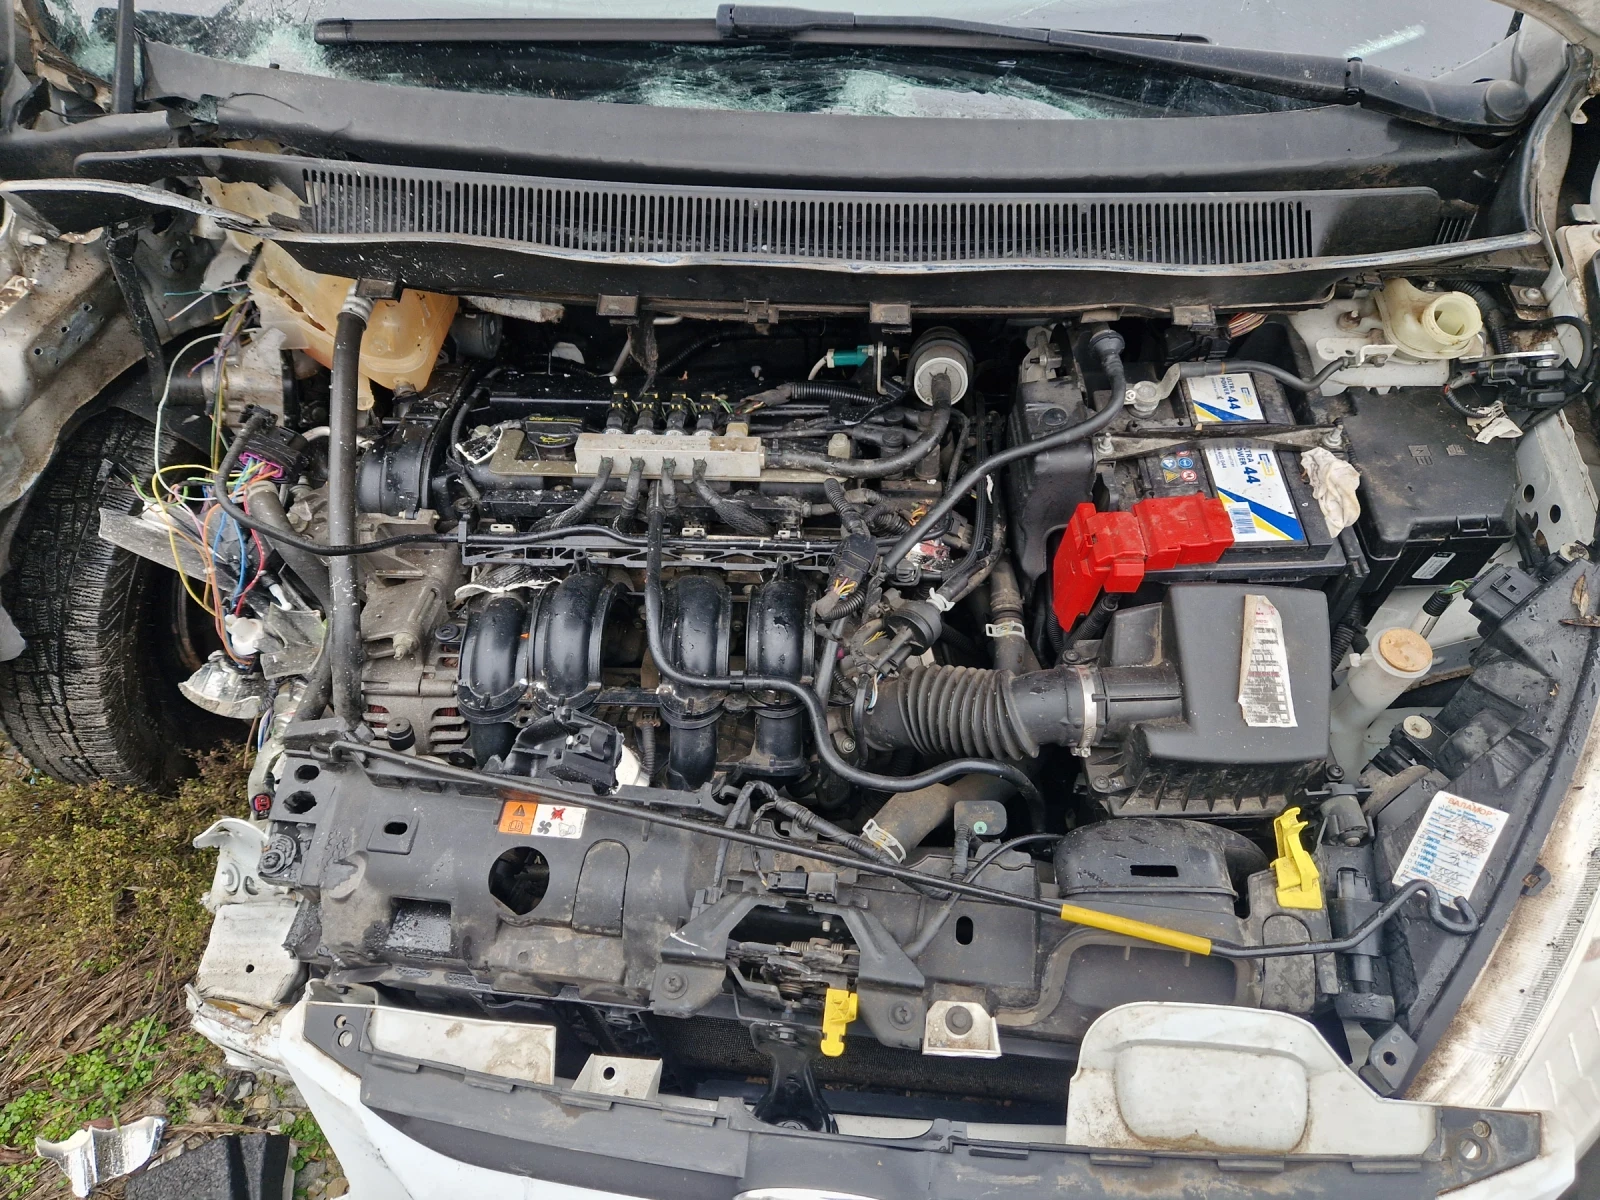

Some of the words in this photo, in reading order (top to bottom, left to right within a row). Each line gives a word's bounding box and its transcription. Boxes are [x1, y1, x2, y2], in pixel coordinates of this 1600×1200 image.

[1220, 377, 1230, 395] POWER
[1226, 376, 1237, 393] ULTRA
[1227, 396, 1241, 410] 44
[1236, 447, 1247, 466] OWER
[1243, 466, 1261, 484] 44
